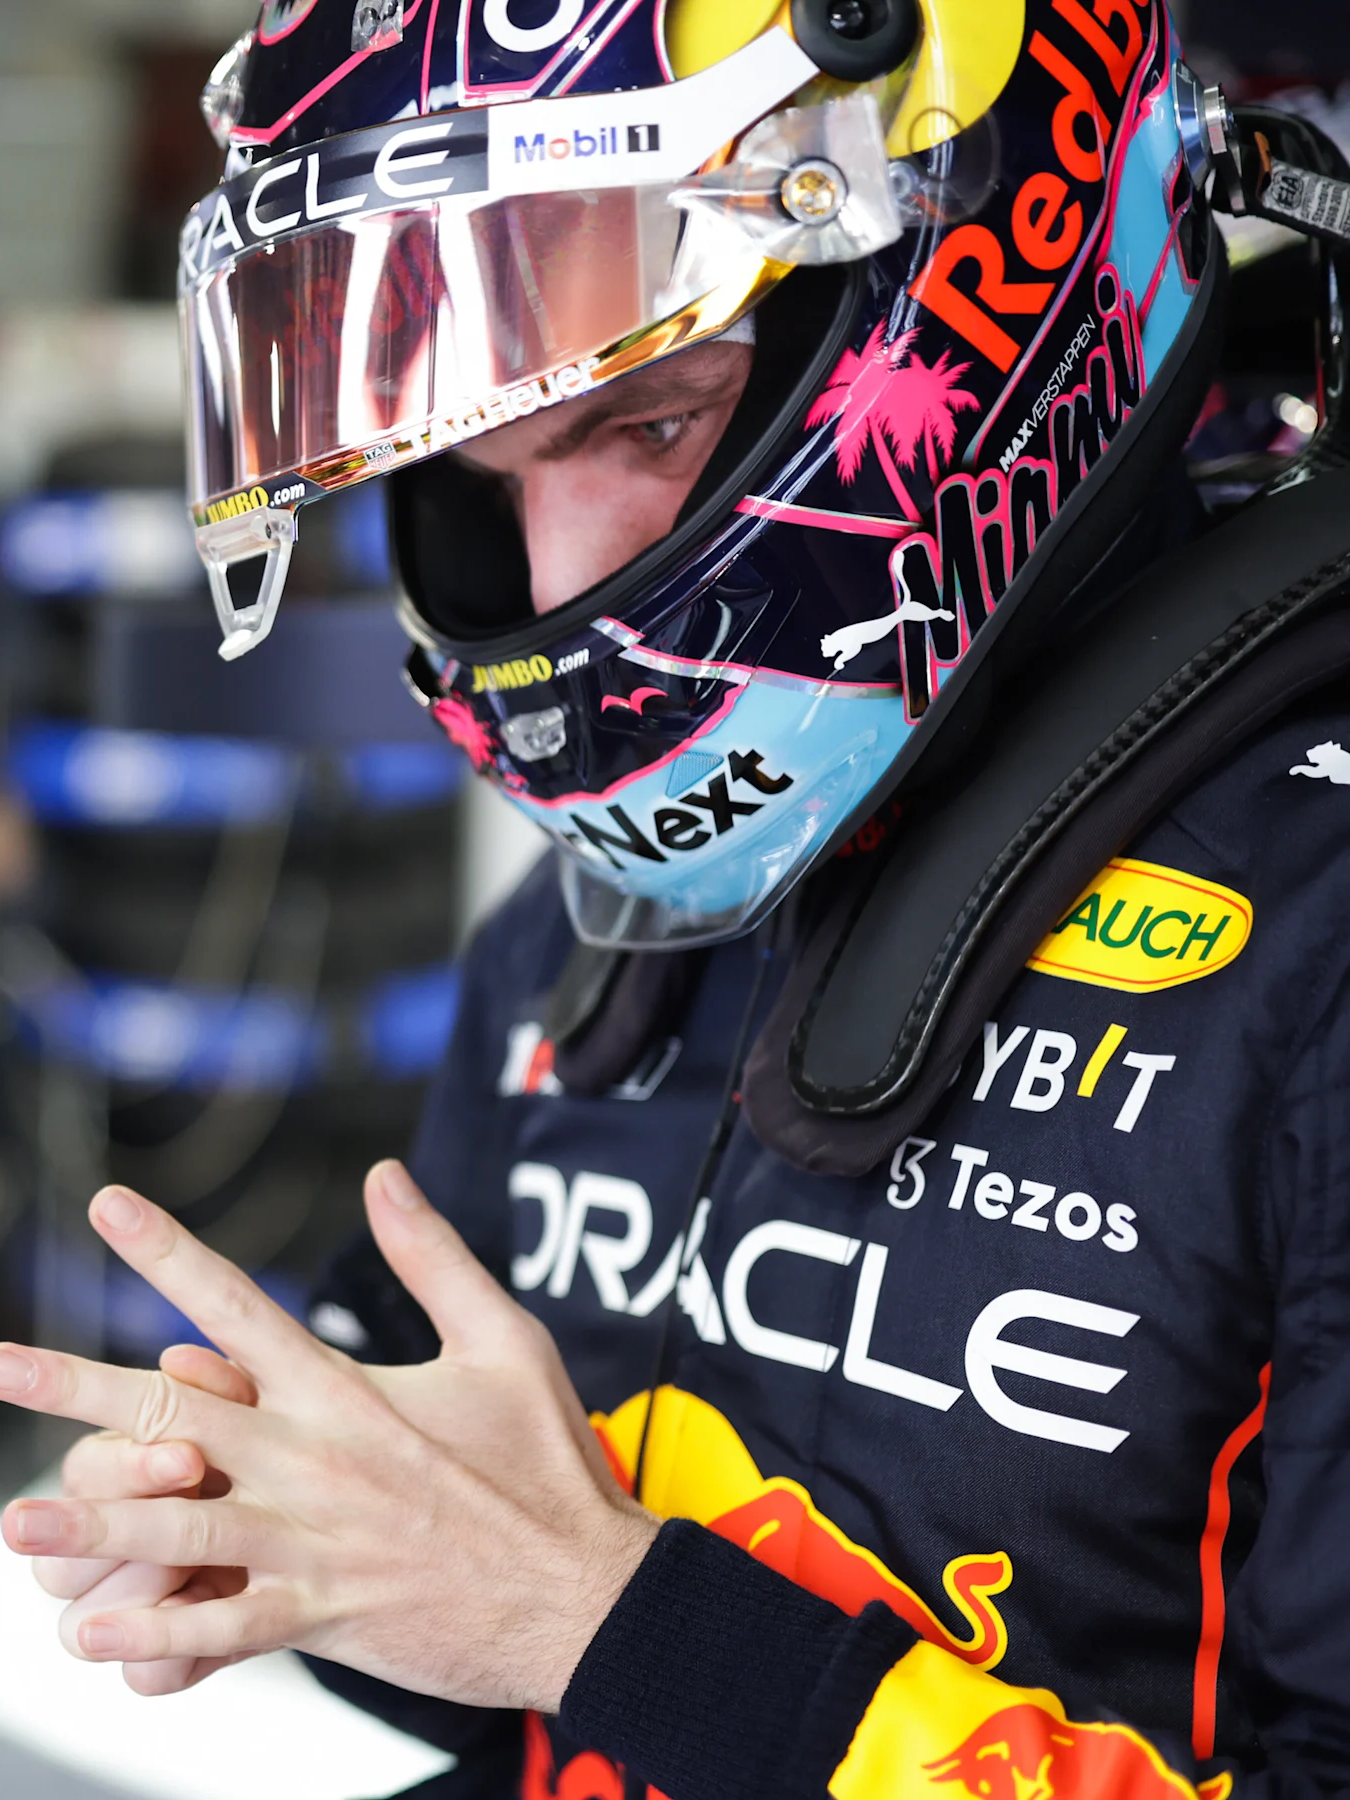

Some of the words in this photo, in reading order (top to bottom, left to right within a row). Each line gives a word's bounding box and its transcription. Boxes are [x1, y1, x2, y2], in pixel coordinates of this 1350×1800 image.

[515, 126, 617, 163] Mobil
[907, 0, 1149, 374] RedB
[177, 121, 454, 282] RACLE
[366, 443, 392, 460] TAG
[567, 749, 794, 870] Next
[1052, 893, 1232, 962] AUCH
[971, 1022, 1177, 1133] YBIT
[947, 1143, 1140, 1252] Tezos
